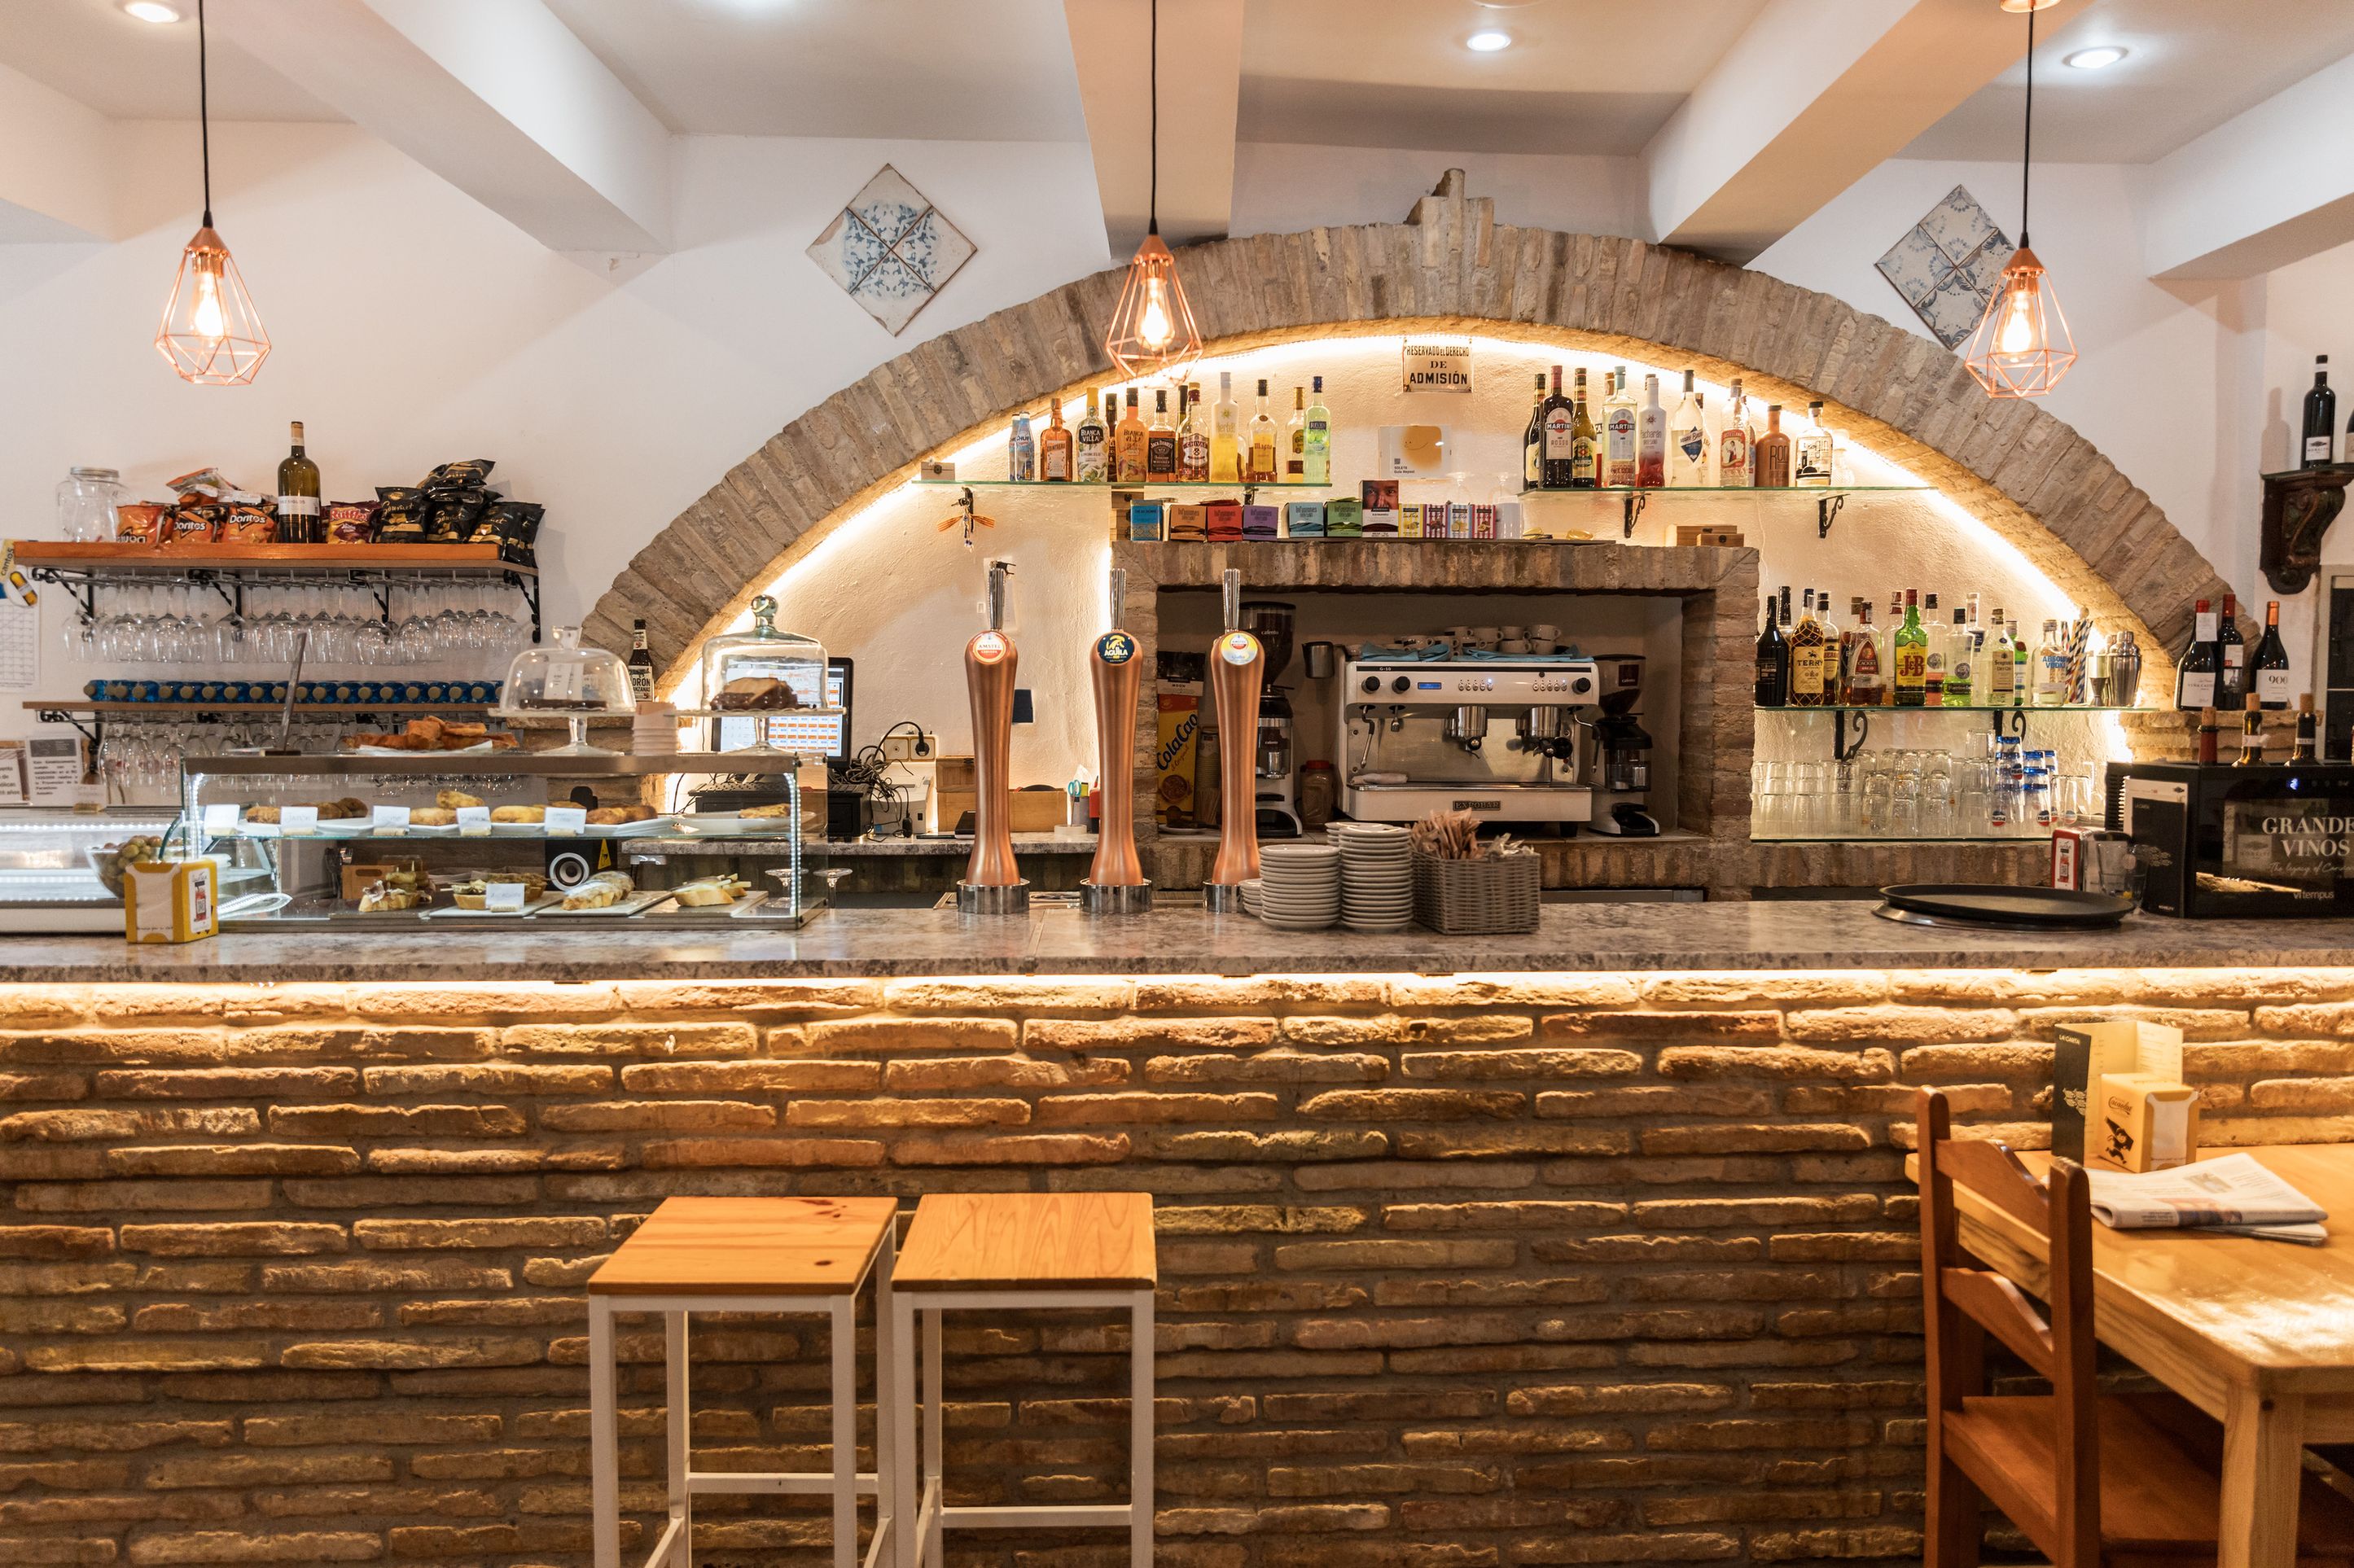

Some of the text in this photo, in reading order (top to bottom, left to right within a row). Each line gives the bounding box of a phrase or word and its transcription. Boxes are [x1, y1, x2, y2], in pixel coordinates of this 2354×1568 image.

[1406, 345, 1440, 357] RESERVADO
[1445, 346, 1470, 357] DERECHO
[1430, 361, 1447, 369] DE
[1409, 370, 1468, 385] ADMISIÓN
[1124, 429, 1143, 437] BIANCA
[173, 521, 206, 531] Doritos
[230, 515, 265, 523] Doritos
[1, 548, 14, 576] cantos
[1900, 655, 1925, 677] J&B
[1156, 712, 1199, 771] ColaCao
[2281, 839, 2351, 858] VINOS
[2270, 861, 2282, 873] The
[2286, 861, 2311, 876] legacy
[2313, 860, 2324, 874] of
